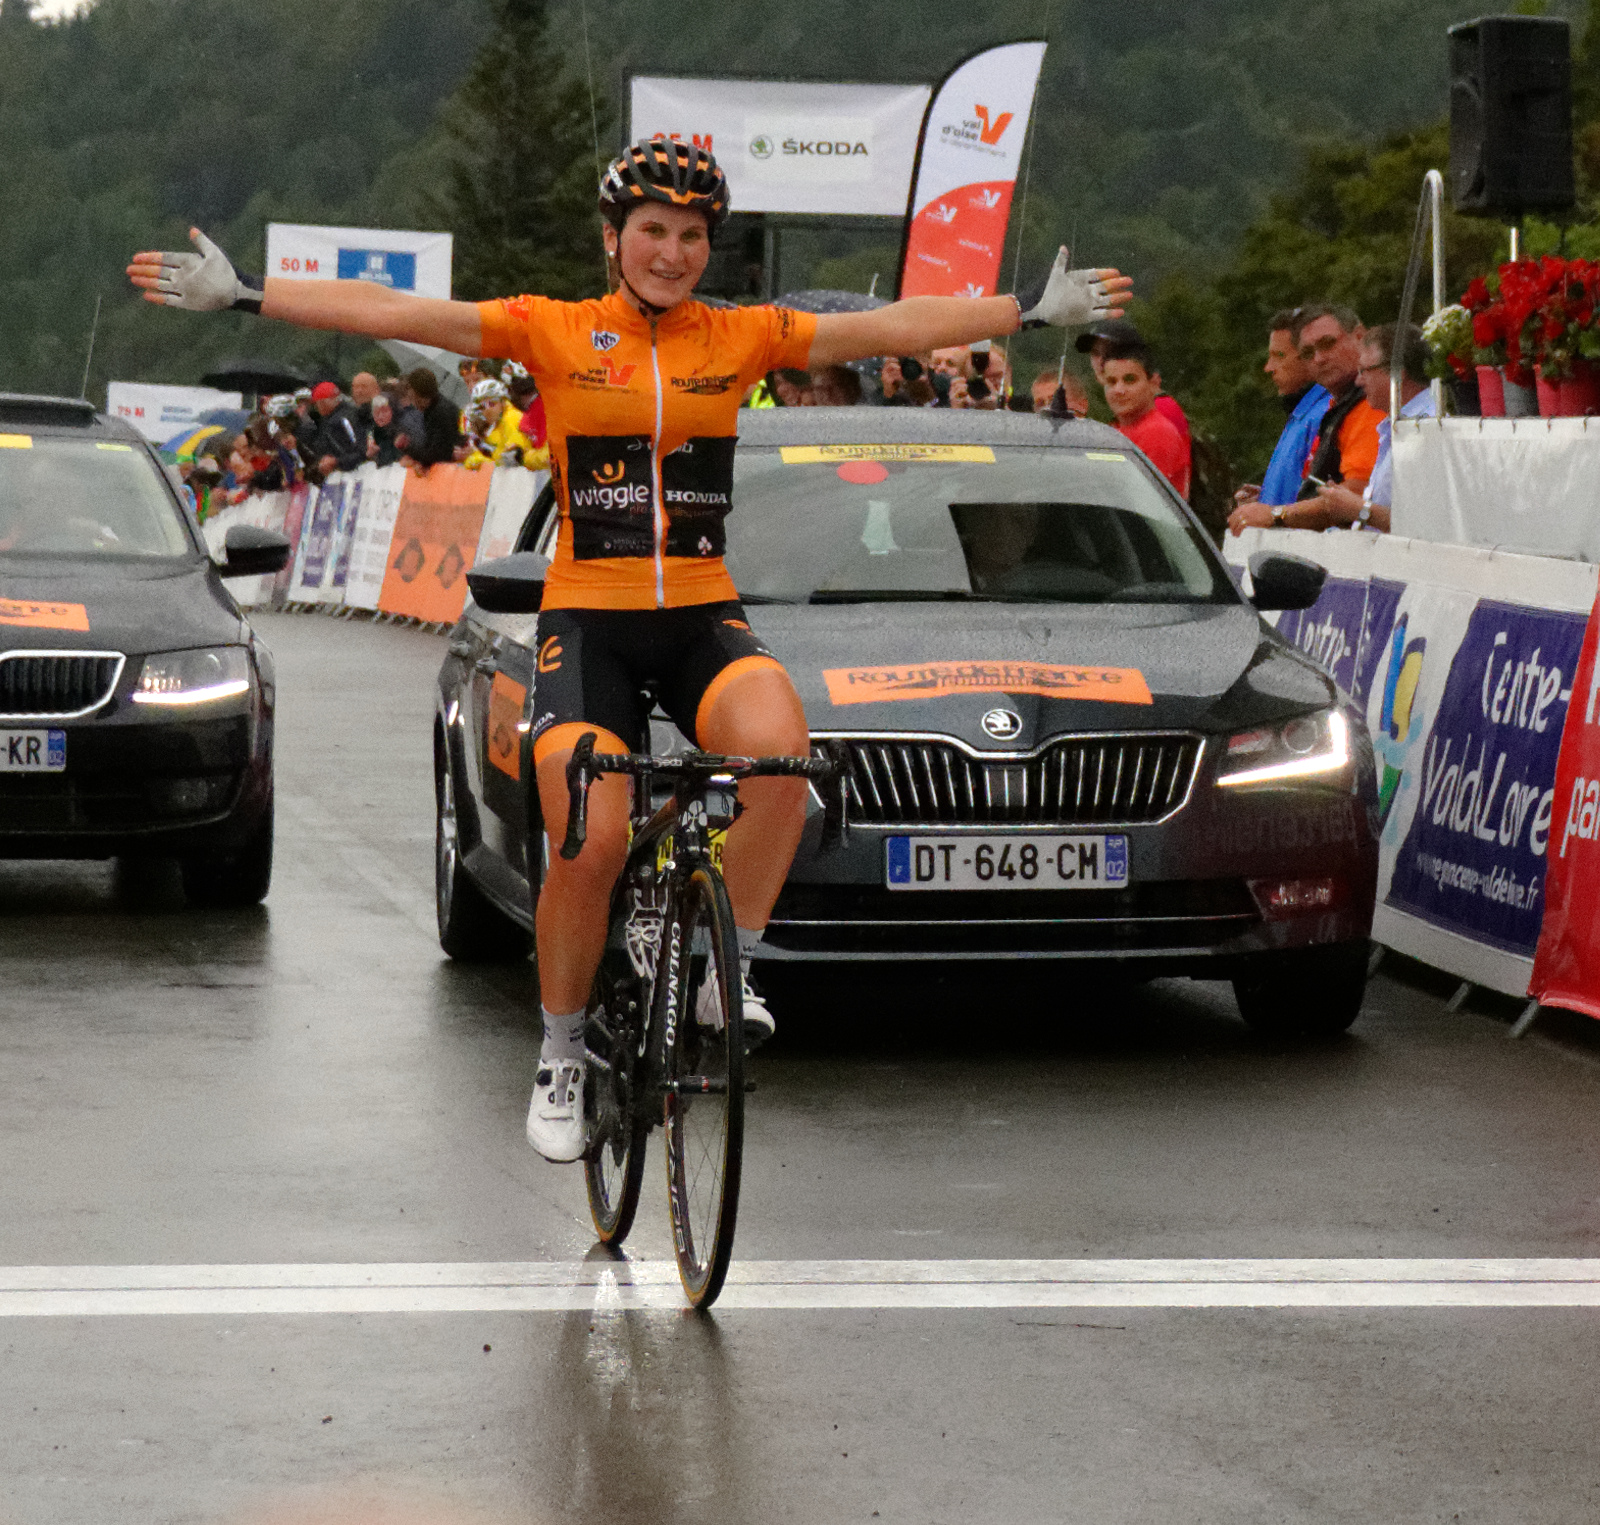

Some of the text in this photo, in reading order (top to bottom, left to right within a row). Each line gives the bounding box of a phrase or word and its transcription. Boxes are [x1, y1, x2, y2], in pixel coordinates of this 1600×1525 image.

[280, 257, 319, 273] 50 M
[574, 482, 650, 510] wiggle
[665, 489, 728, 504] HONDA
[915, 842, 1098, 881] DT-648-CM
[1106, 860, 1125, 878] 02
[665, 921, 681, 1047] COLNAGO
